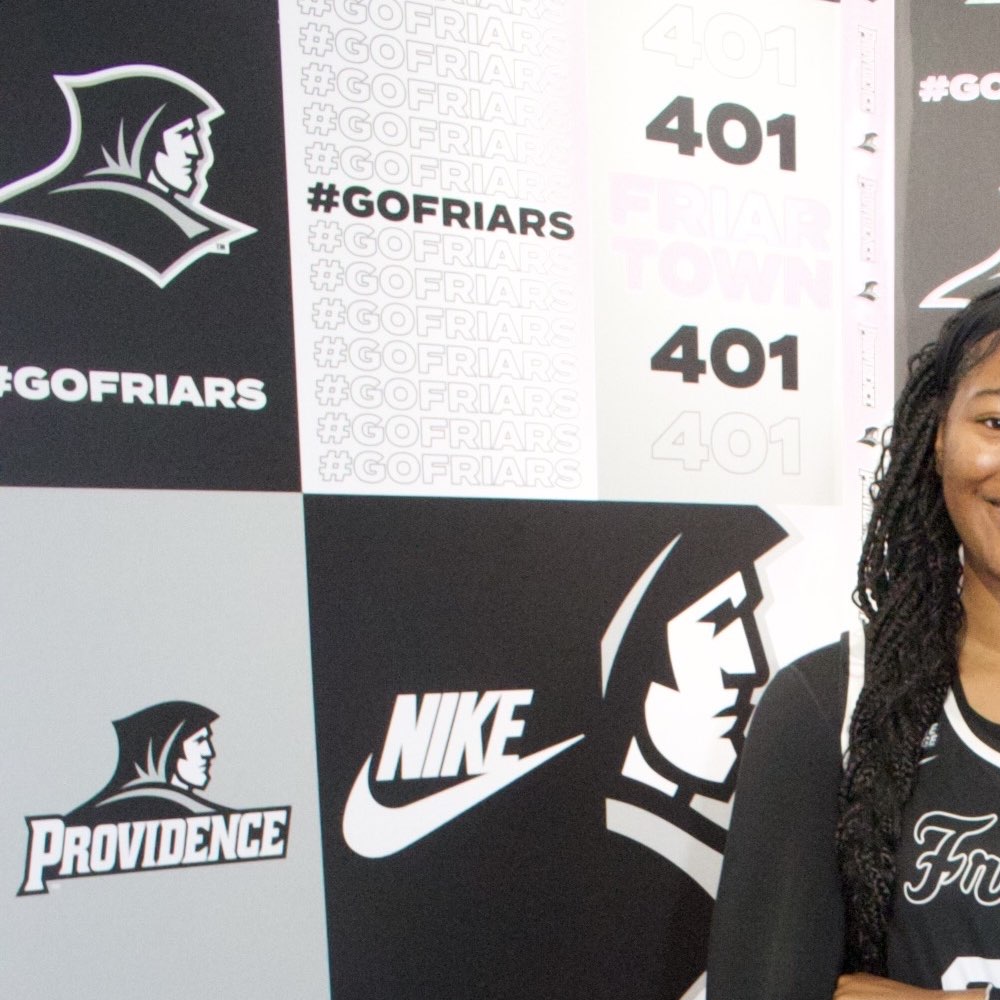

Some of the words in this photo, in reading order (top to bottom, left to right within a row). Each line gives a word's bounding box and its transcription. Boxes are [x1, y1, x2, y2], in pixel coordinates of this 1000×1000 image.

[642, 3, 796, 88] 401
[645, 95, 797, 172] 401
[307, 182, 575, 241] #GOFRIARS
[608, 171, 832, 251] FRIAR
[611, 235, 833, 309] TOWN
[311, 297, 578, 349] #GOFRIARS
[313, 336, 579, 384] #GOFRIARS
[650, 325, 799, 391] 401
[315, 374, 580, 419] #GOFRIARS
[317, 413, 581, 454] #GOFRIARS
[651, 410, 801, 475] 401
[319, 451, 581, 488] #GOFRIARS
[376, 689, 534, 781] NIKE
[18, 806, 290, 895] PROVIDENCE
